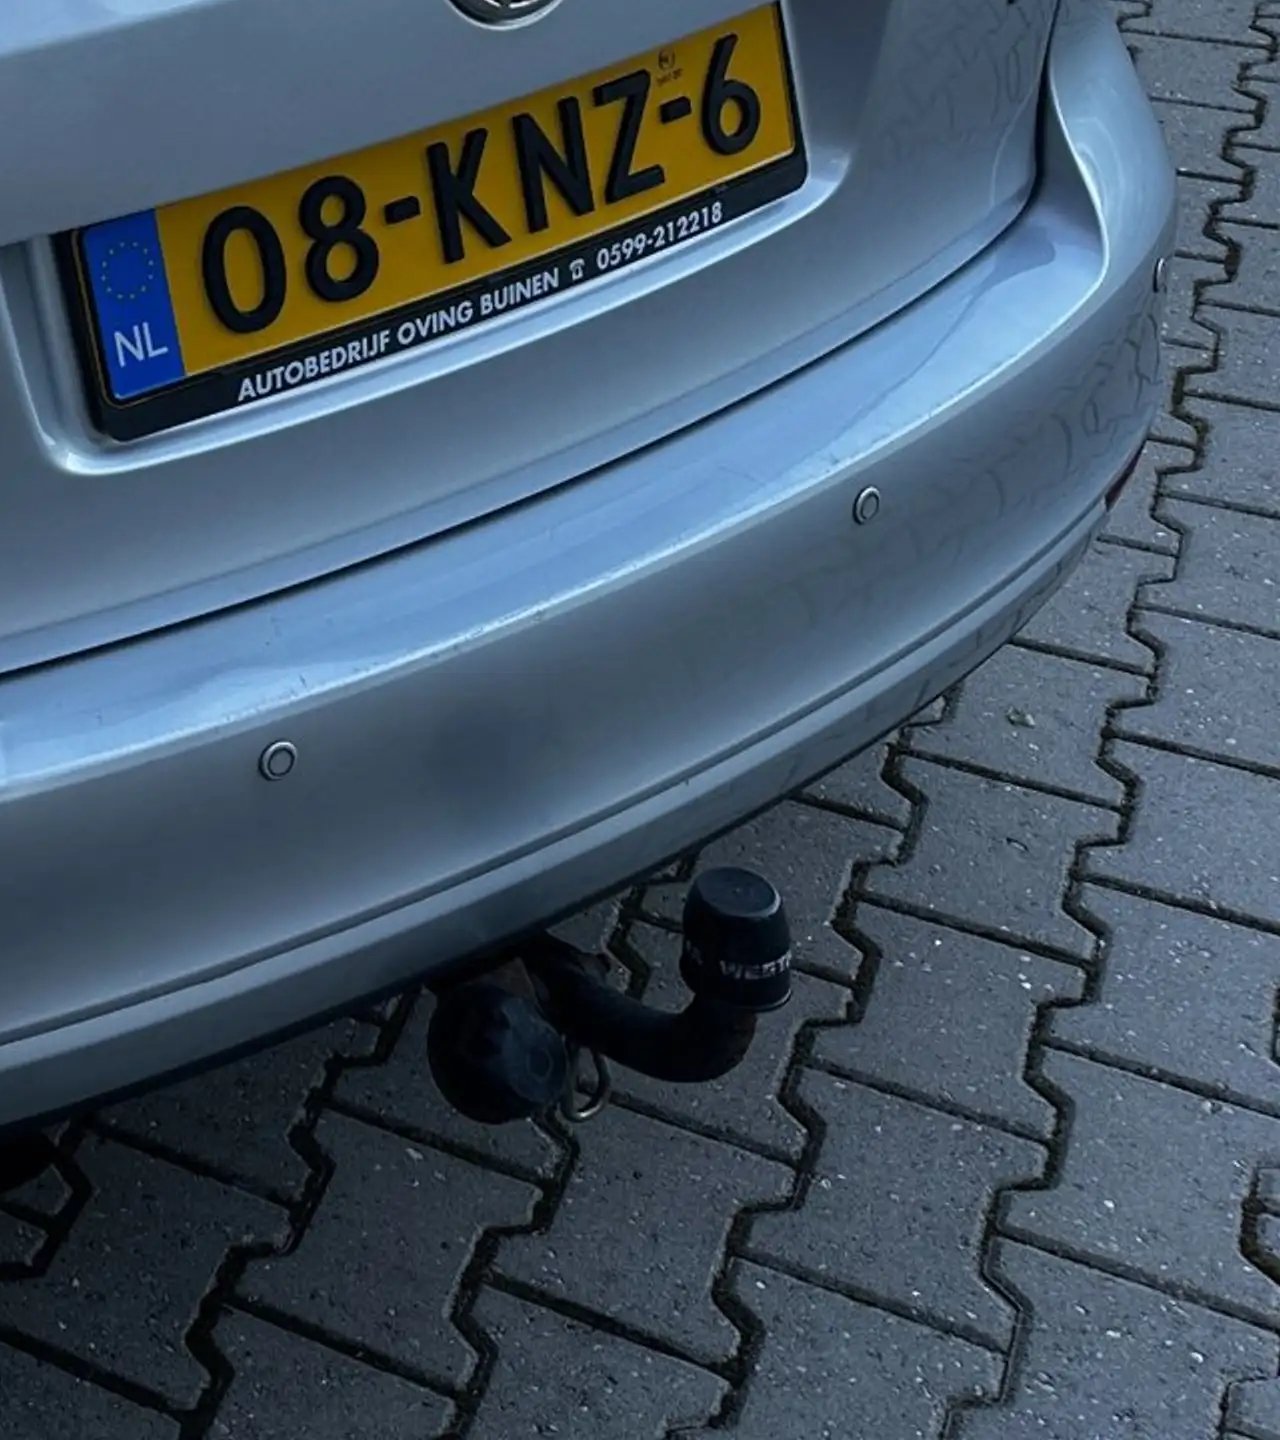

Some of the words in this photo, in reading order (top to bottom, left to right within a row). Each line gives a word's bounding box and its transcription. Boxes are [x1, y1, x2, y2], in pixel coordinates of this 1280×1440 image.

[202, 34, 761, 334] 08-KNZ-6
[113, 321, 168, 366] NL
[238, 330, 390, 402] AUTOBEDRIJF
[397, 301, 473, 346] OVING
[480, 268, 559, 316] BUINEN
[596, 201, 724, 270] 0599-212218
